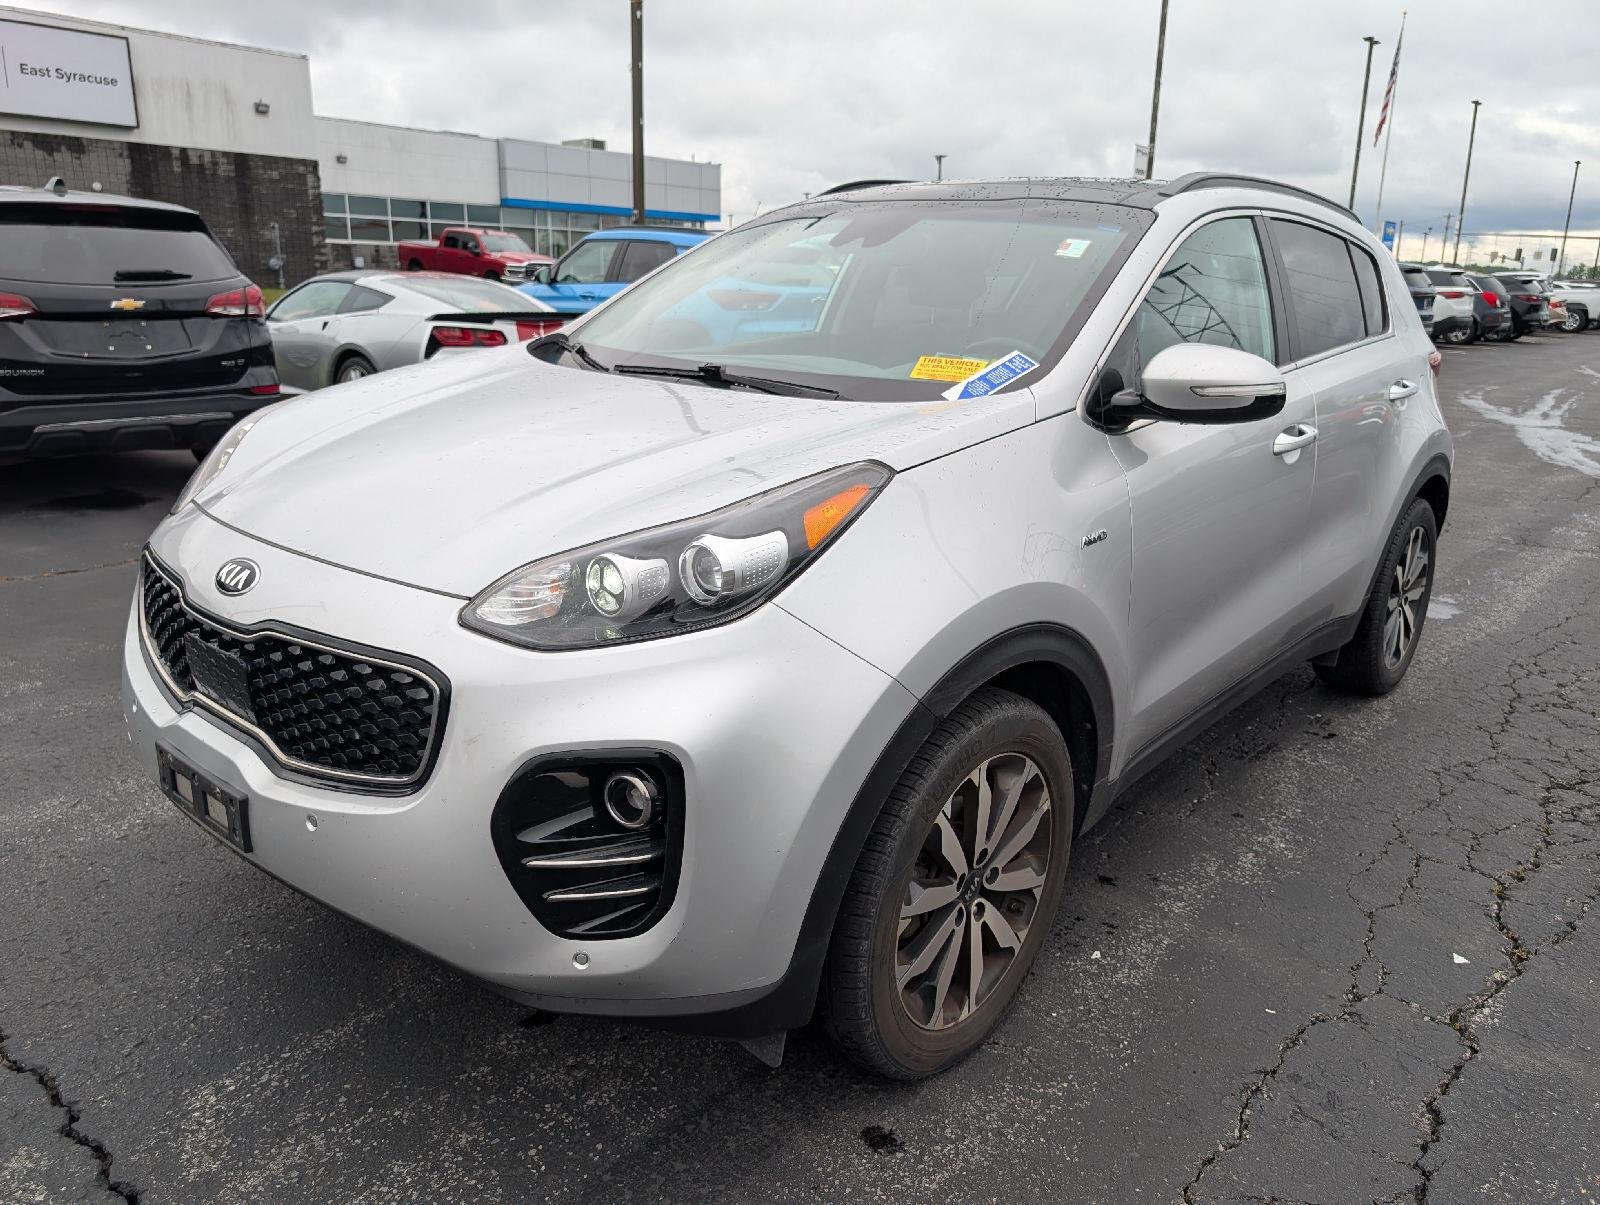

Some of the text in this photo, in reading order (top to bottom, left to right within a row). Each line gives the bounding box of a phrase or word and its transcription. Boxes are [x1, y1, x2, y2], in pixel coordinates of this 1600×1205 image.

[20, 63, 118, 86] East Syracuse
[945, 359, 981, 368] VEHICLE
[1080, 530, 1107, 549] AWD
[219, 562, 251, 590] KIA
